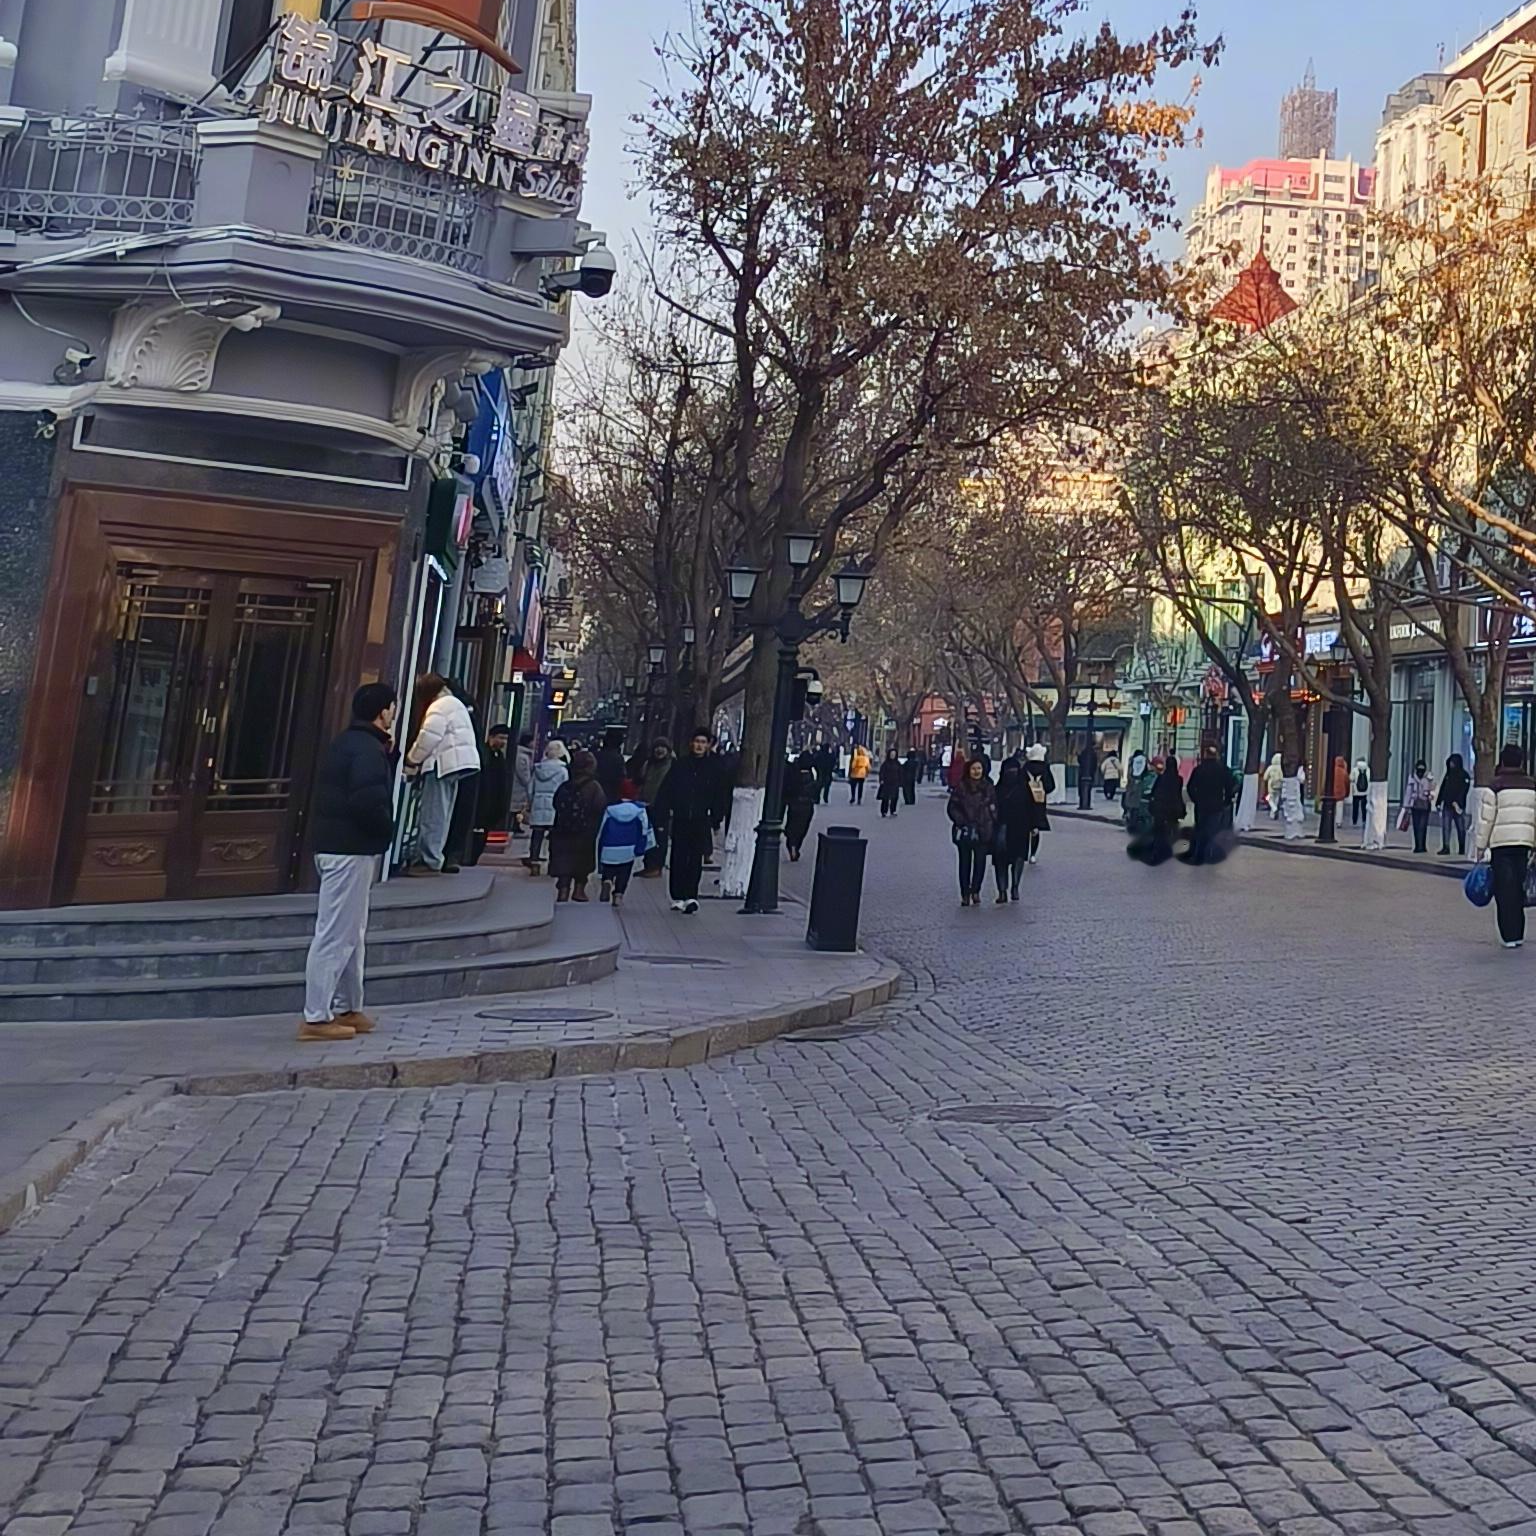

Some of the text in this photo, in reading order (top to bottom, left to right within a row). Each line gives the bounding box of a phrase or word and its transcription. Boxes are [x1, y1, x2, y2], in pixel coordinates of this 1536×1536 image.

[262, 82, 448, 170] JINJIANG
[448, 147, 517, 192] INN
[281, 11, 541, 160] 锦江之星
